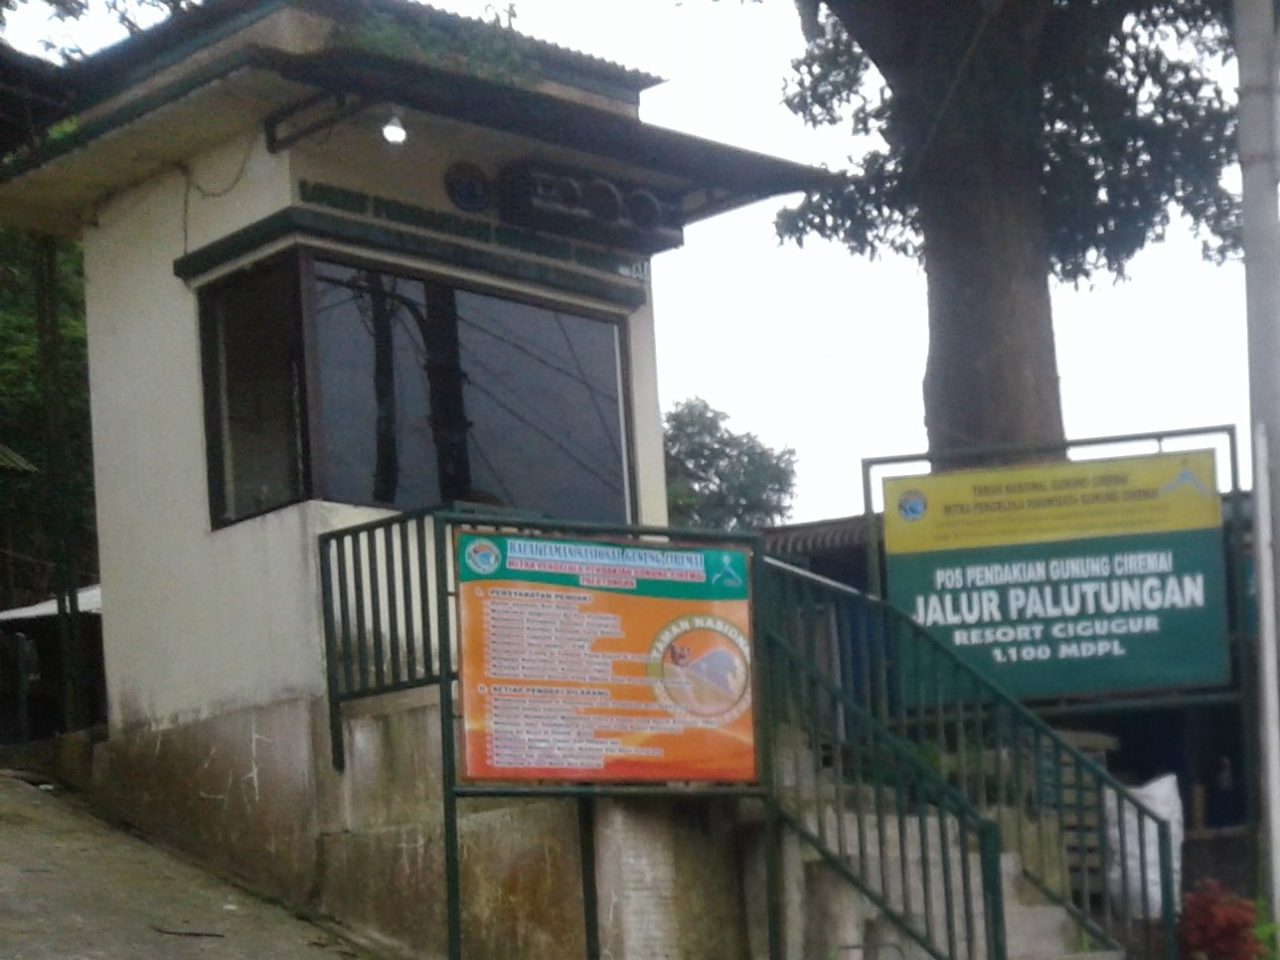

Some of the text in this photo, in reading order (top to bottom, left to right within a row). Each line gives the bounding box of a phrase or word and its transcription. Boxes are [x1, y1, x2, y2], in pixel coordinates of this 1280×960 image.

[936, 551, 1174, 590] POS PENDAKIAN GUNUNG CIREMAI
[912, 573, 1206, 627] JALUR PALUTUNGAN
[953, 616, 1160, 646] RESORT CIGUGUR
[1058, 639, 1126, 660] MDPL
